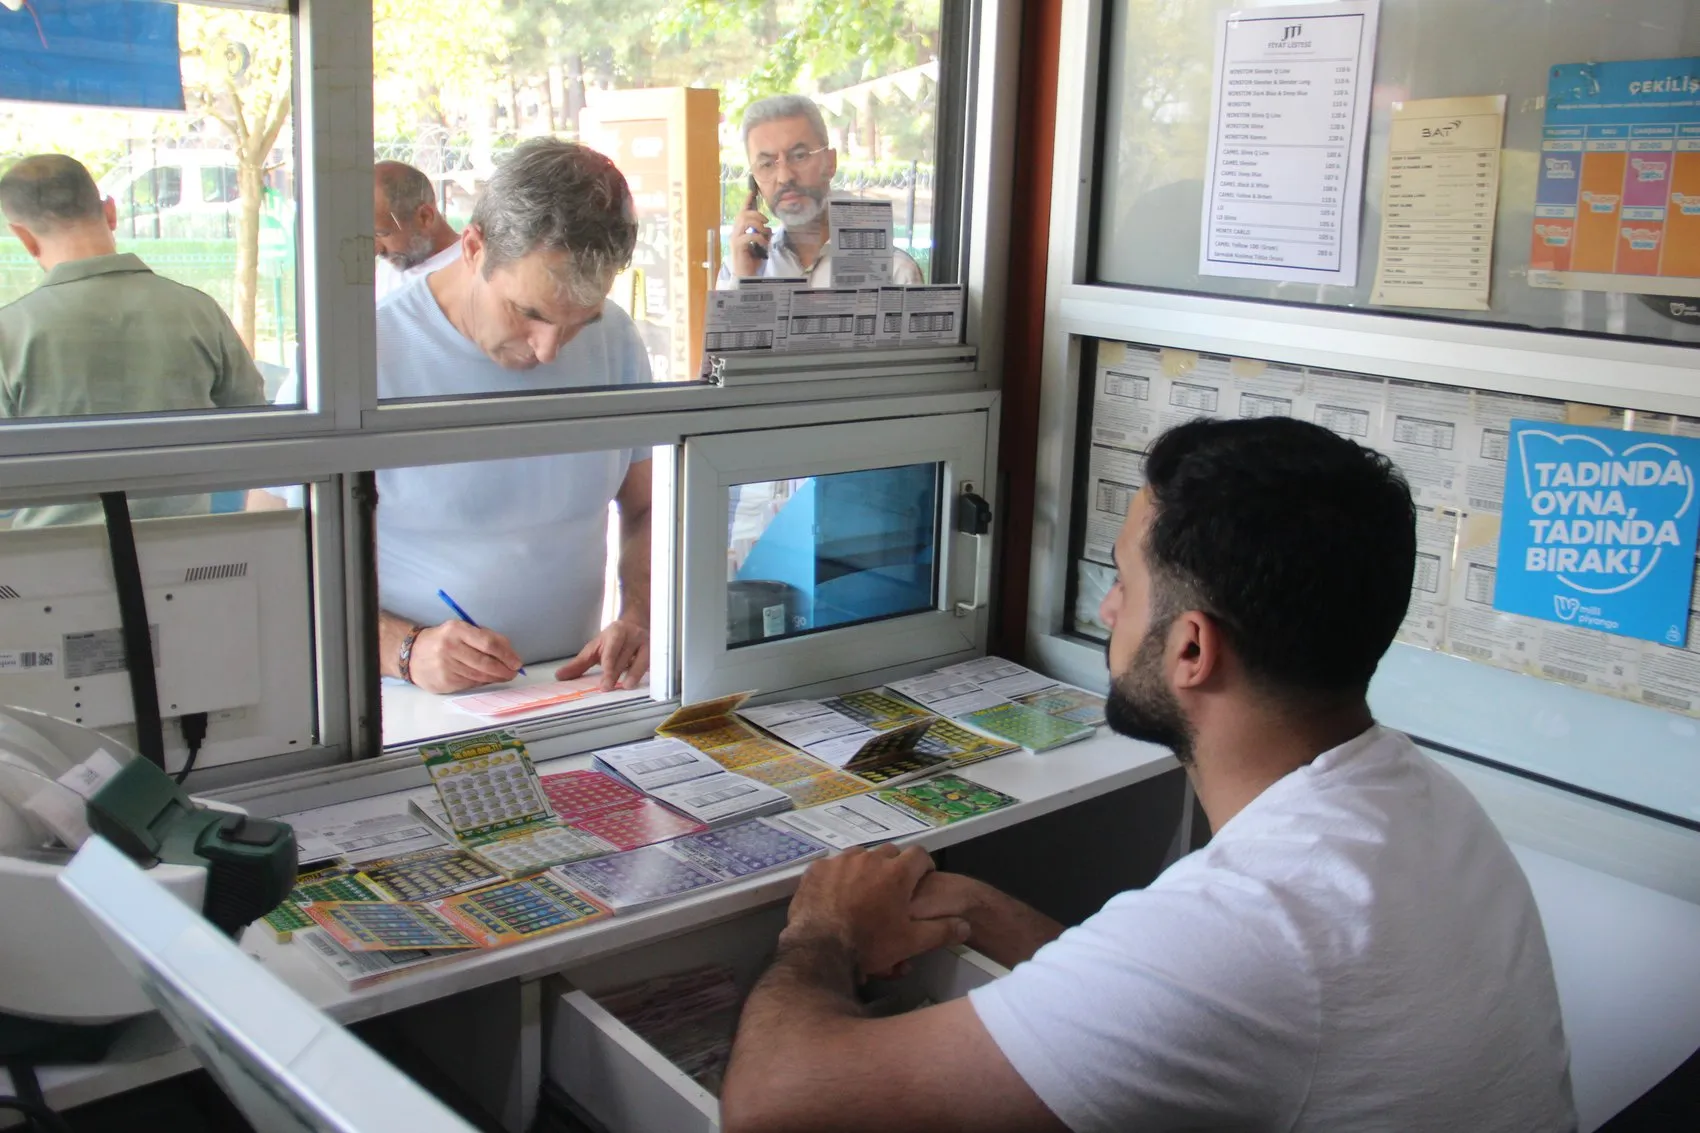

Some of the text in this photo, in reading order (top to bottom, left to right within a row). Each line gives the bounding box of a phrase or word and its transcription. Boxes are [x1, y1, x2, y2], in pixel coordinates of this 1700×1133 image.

[1534, 460, 1687, 487] TADINDA
[1532, 490, 1637, 520] OYNA,
[1528, 520, 1680, 546] TADINDA
[1525, 548, 1641, 574] BIRAK!
[1578, 615, 1619, 629] piyango
